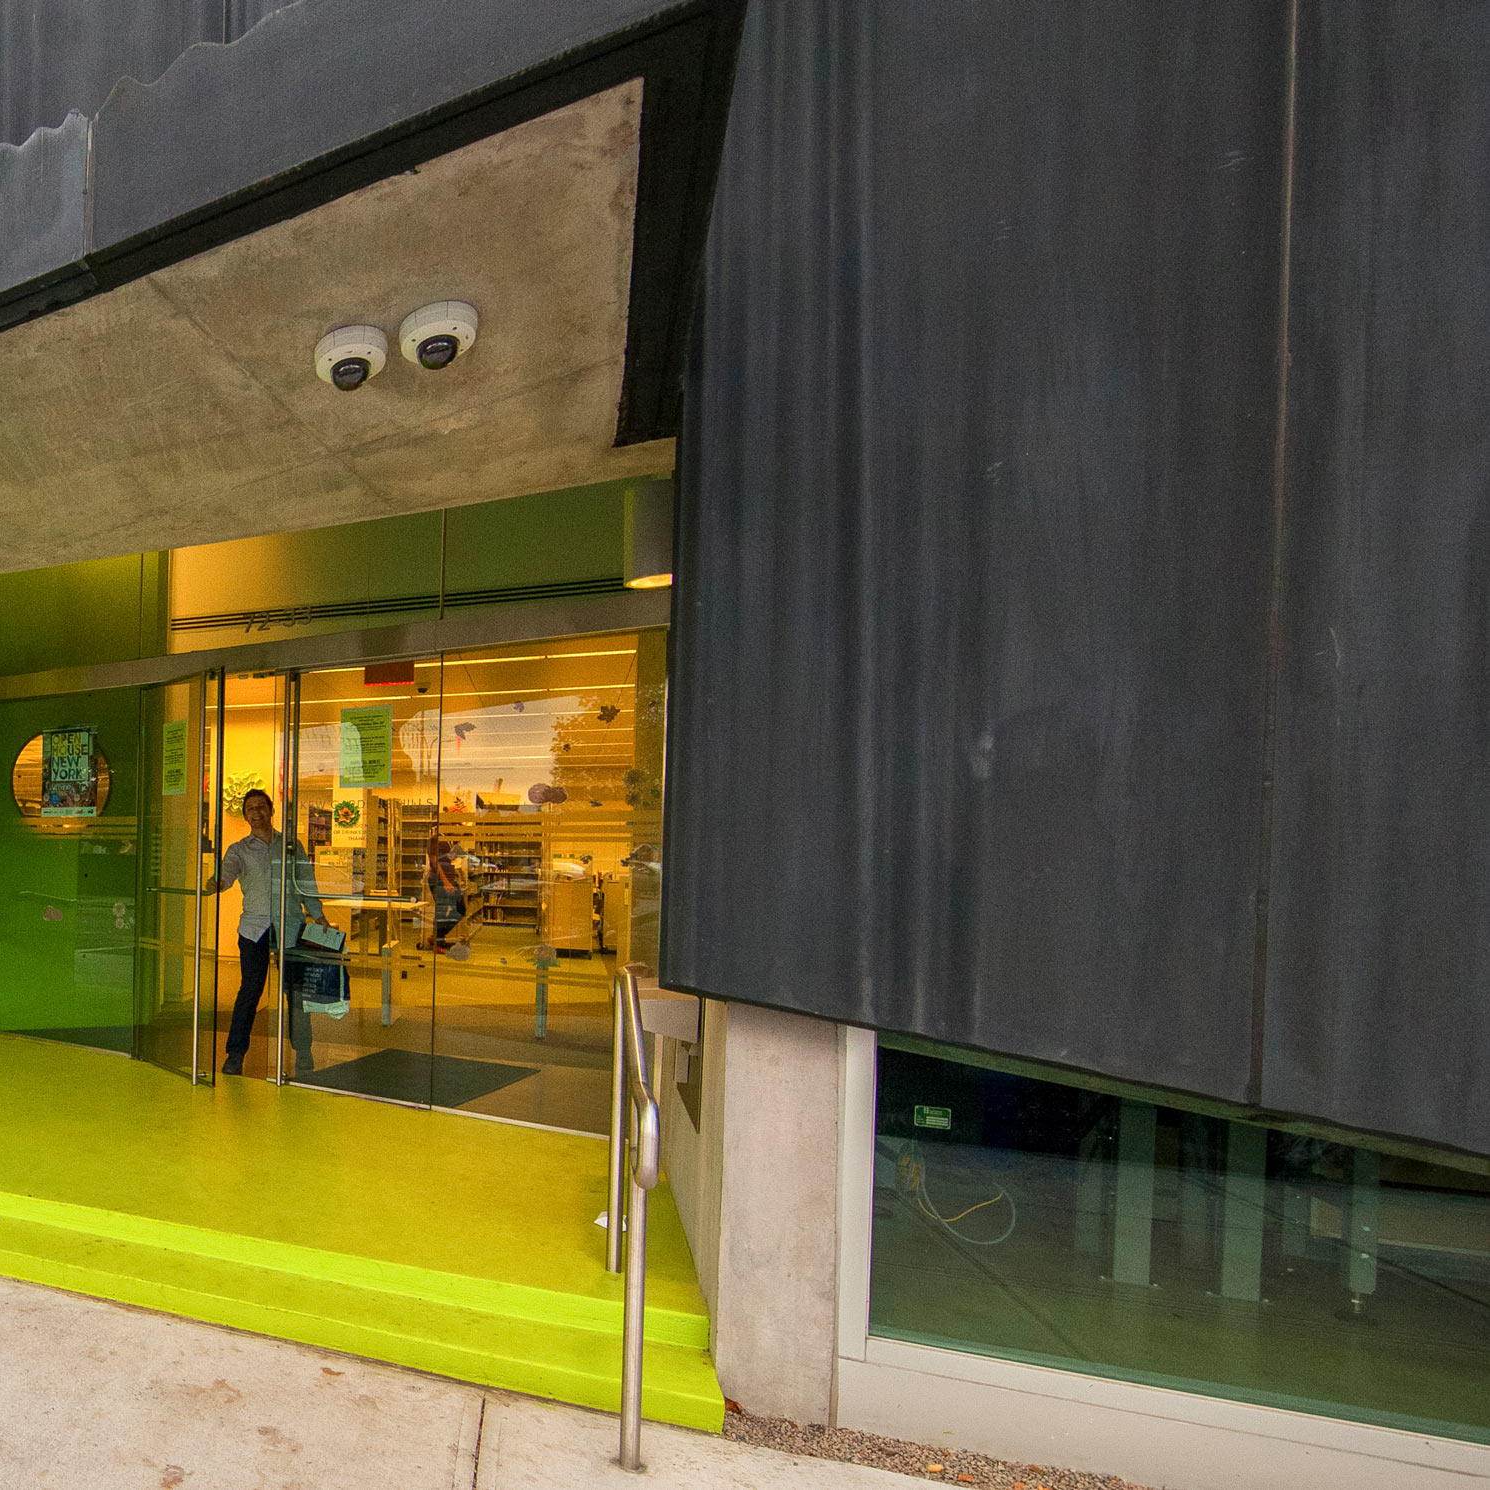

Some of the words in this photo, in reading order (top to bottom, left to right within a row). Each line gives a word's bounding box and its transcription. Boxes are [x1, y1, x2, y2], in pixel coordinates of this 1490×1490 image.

[242, 605, 312, 633] 72-33
[52, 733, 81, 745] OPEN
[52, 743, 89, 756] HOUSE
[52, 755, 79, 767] NEW
[52, 768, 82, 780] YORK
